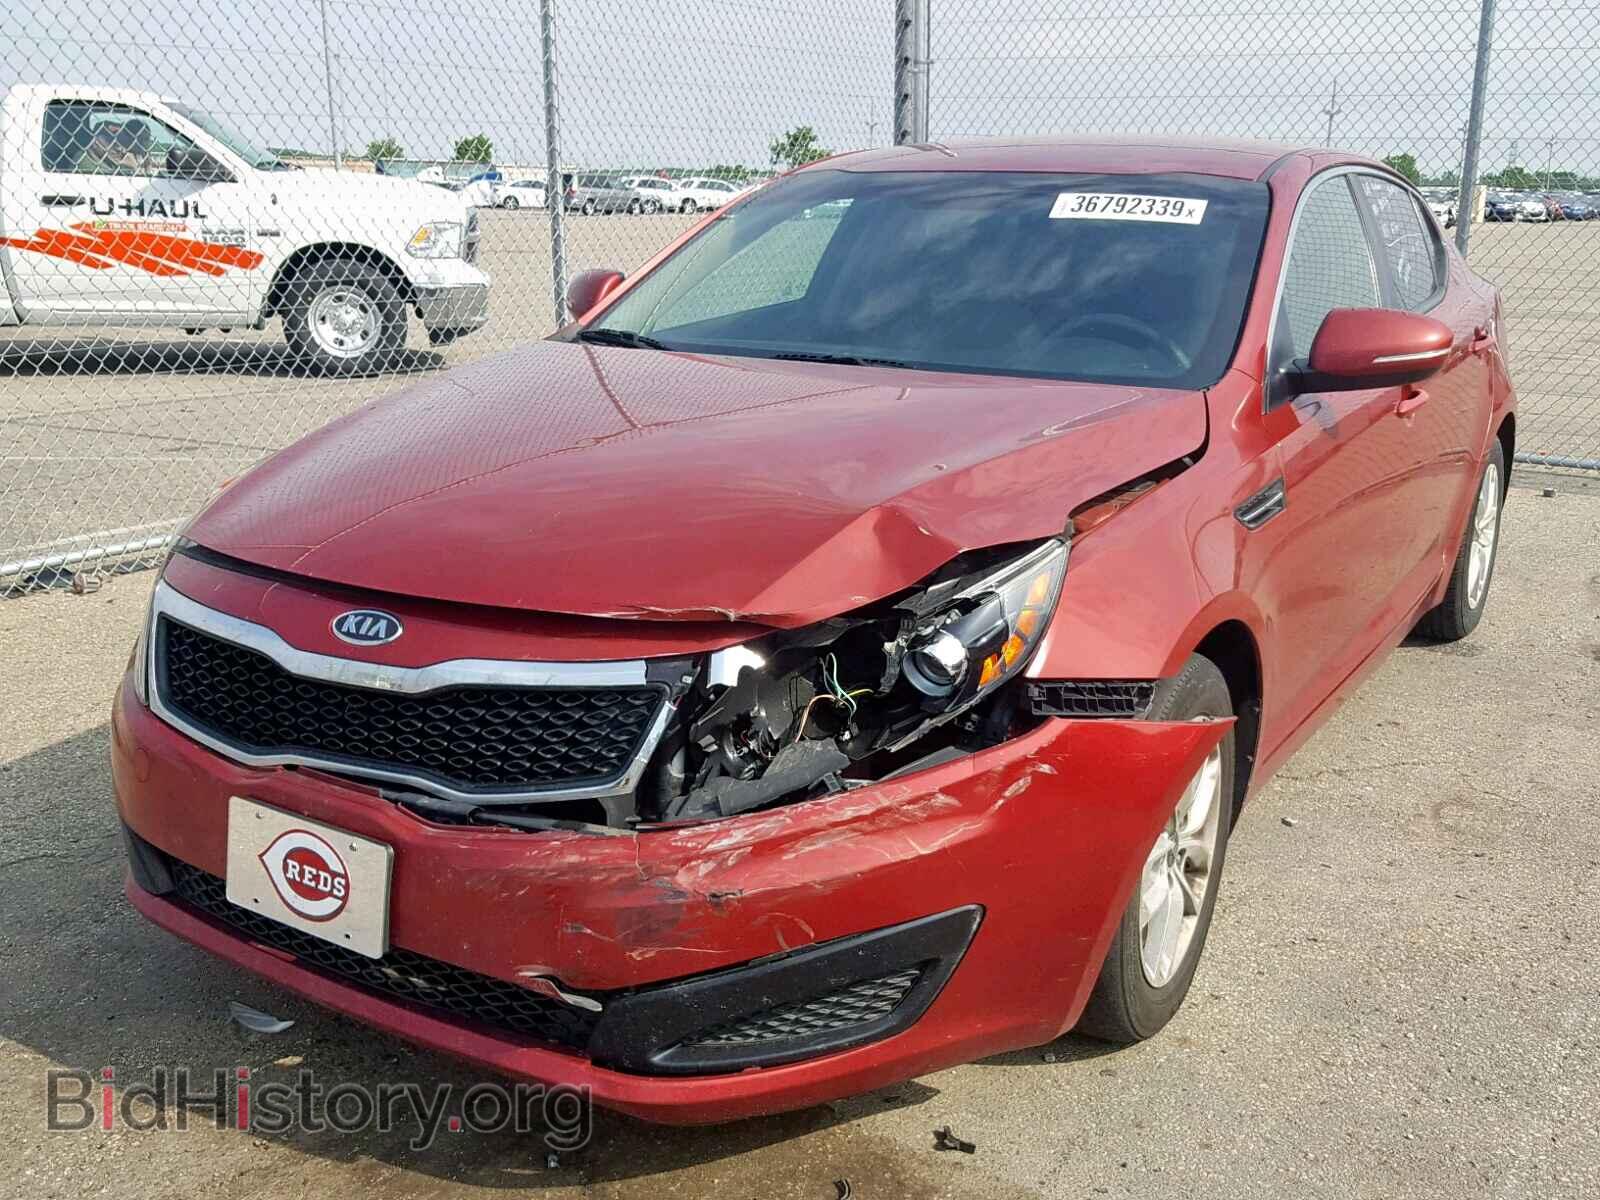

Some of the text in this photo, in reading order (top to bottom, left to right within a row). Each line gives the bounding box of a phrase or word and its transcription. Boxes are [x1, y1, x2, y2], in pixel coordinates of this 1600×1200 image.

[1070, 195, 1185, 217] 36792339
[339, 613, 387, 639] KIA
[286, 858, 346, 898] REDS
